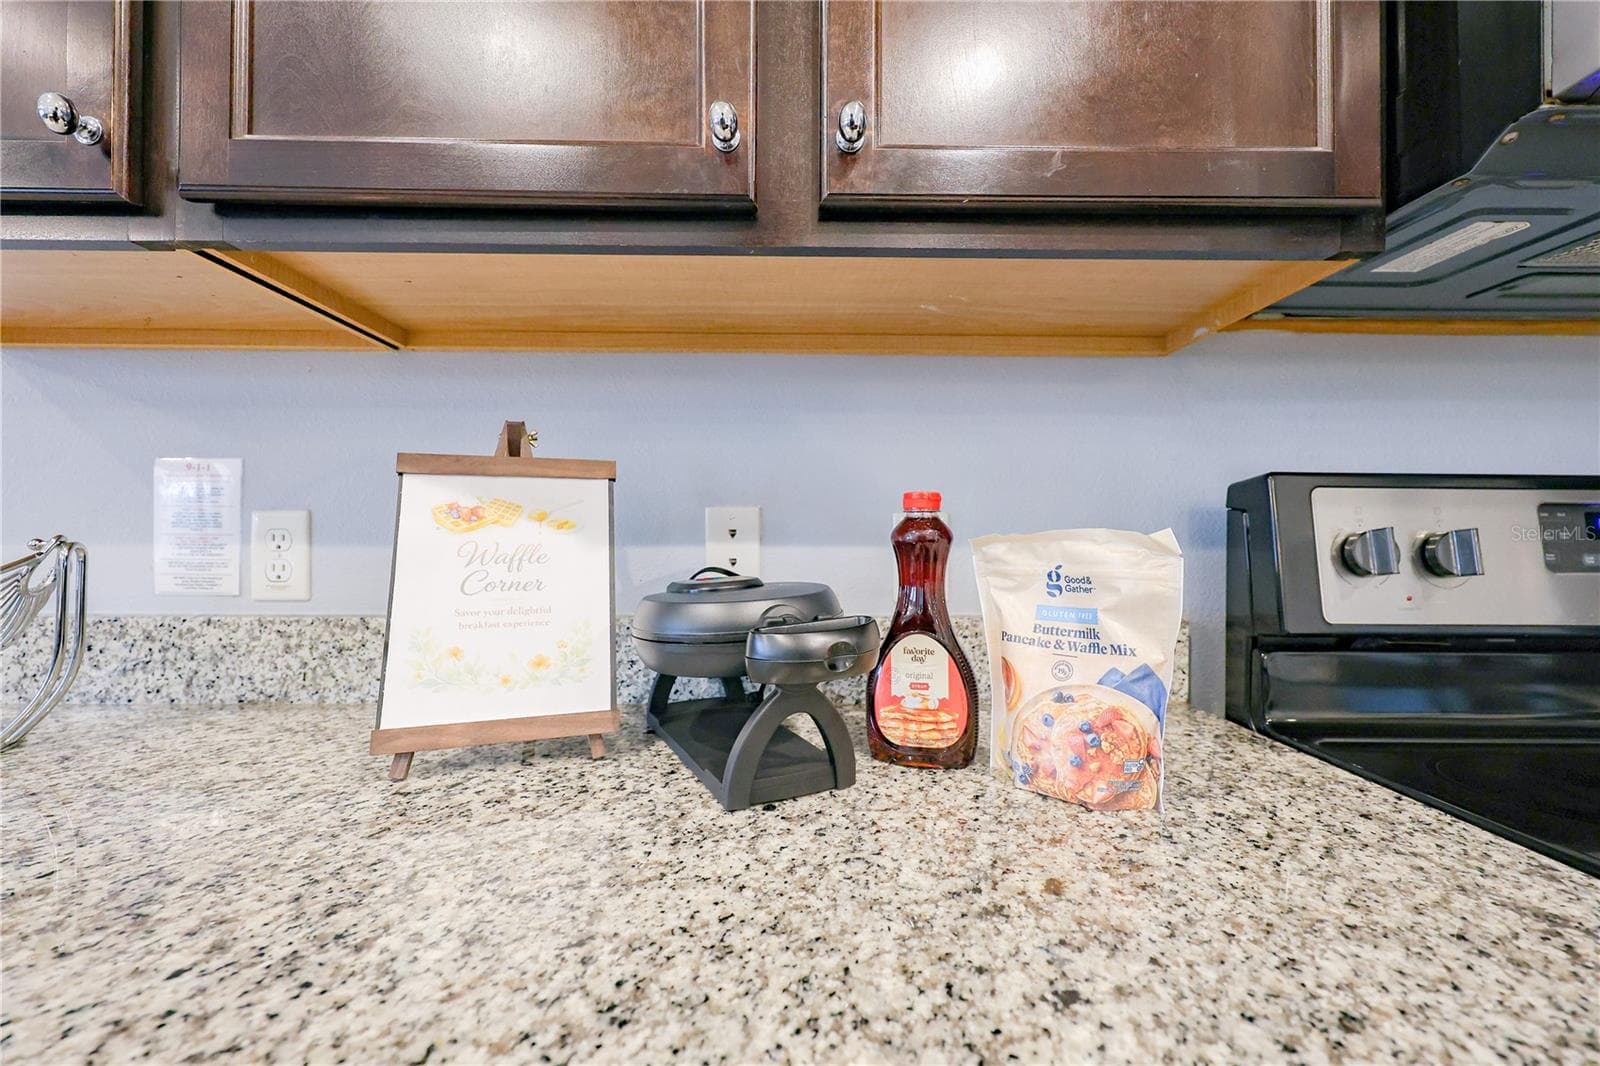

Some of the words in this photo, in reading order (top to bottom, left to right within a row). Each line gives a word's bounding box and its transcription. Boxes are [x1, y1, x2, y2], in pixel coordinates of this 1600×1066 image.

[457, 540, 550, 572] Waffle
[460, 569, 547, 596] Corner
[1064, 584, 1094, 594] Gather
[454, 607, 481, 617] Savor
[483, 607, 505, 617] your
[507, 605, 552, 617] delightful
[1041, 609, 1076, 619] GLUTEN
[1078, 611, 1093, 620] FREE
[458, 620, 500, 631] breakfast
[502, 619, 550, 629] experience
[1033, 623, 1101, 641] Buttermilk
[1001, 630, 1052, 649] Pancake
[1053, 639, 1066, 651] &
[1067, 640, 1108, 655] Waffle
[1110, 643, 1137, 657] Mix
[903, 646, 935, 656] favorite
[911, 655, 927, 665] day
[904, 671, 934, 681] original
